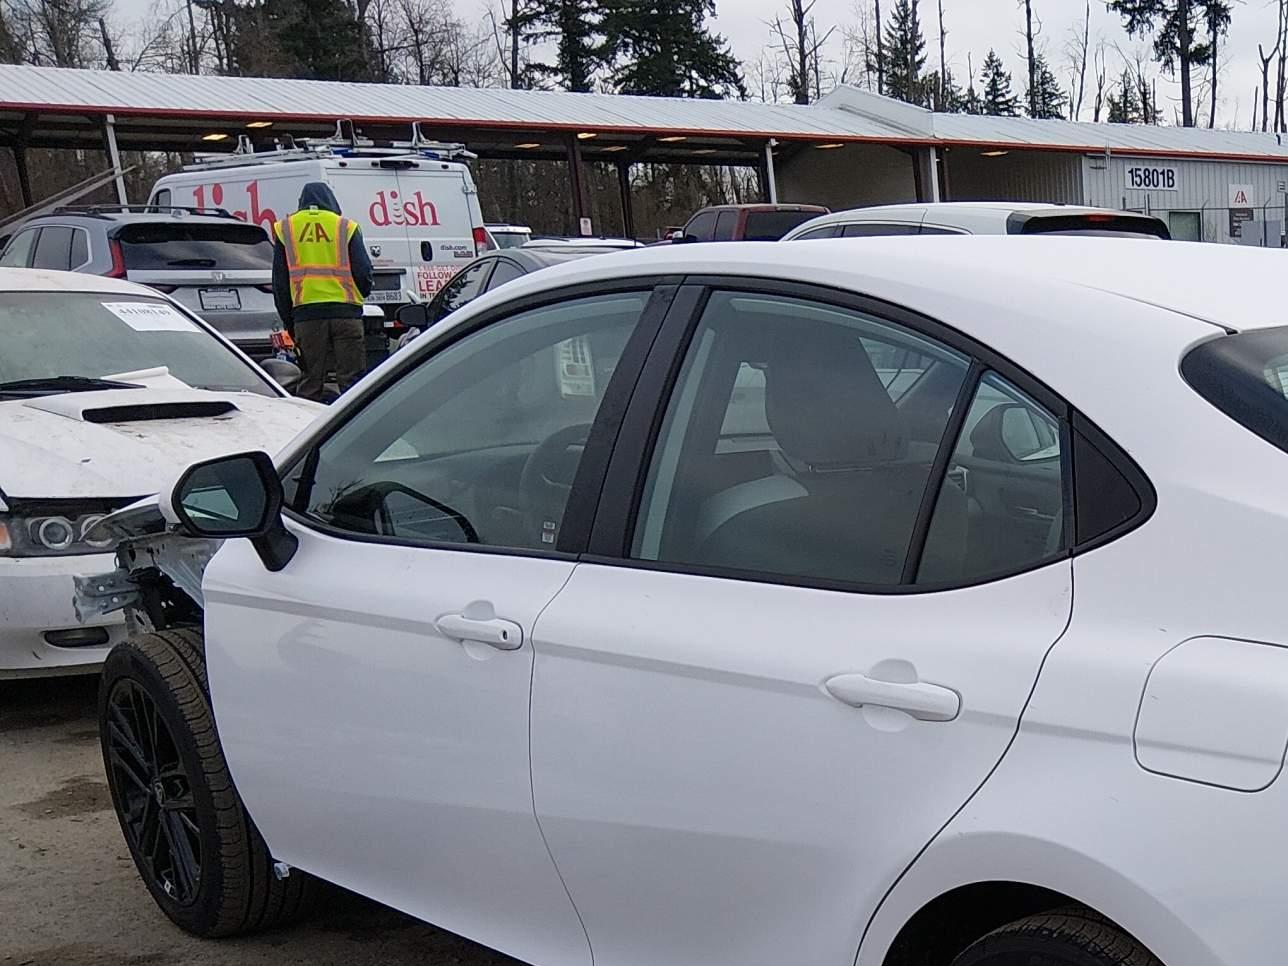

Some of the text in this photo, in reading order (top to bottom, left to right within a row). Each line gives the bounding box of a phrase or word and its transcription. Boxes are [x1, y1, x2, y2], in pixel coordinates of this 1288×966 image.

[1127, 167, 1175, 188] 15801B
[369, 190, 441, 226] dish
[417, 271, 452, 279] FOLLOW
[419, 279, 448, 292] LEA
